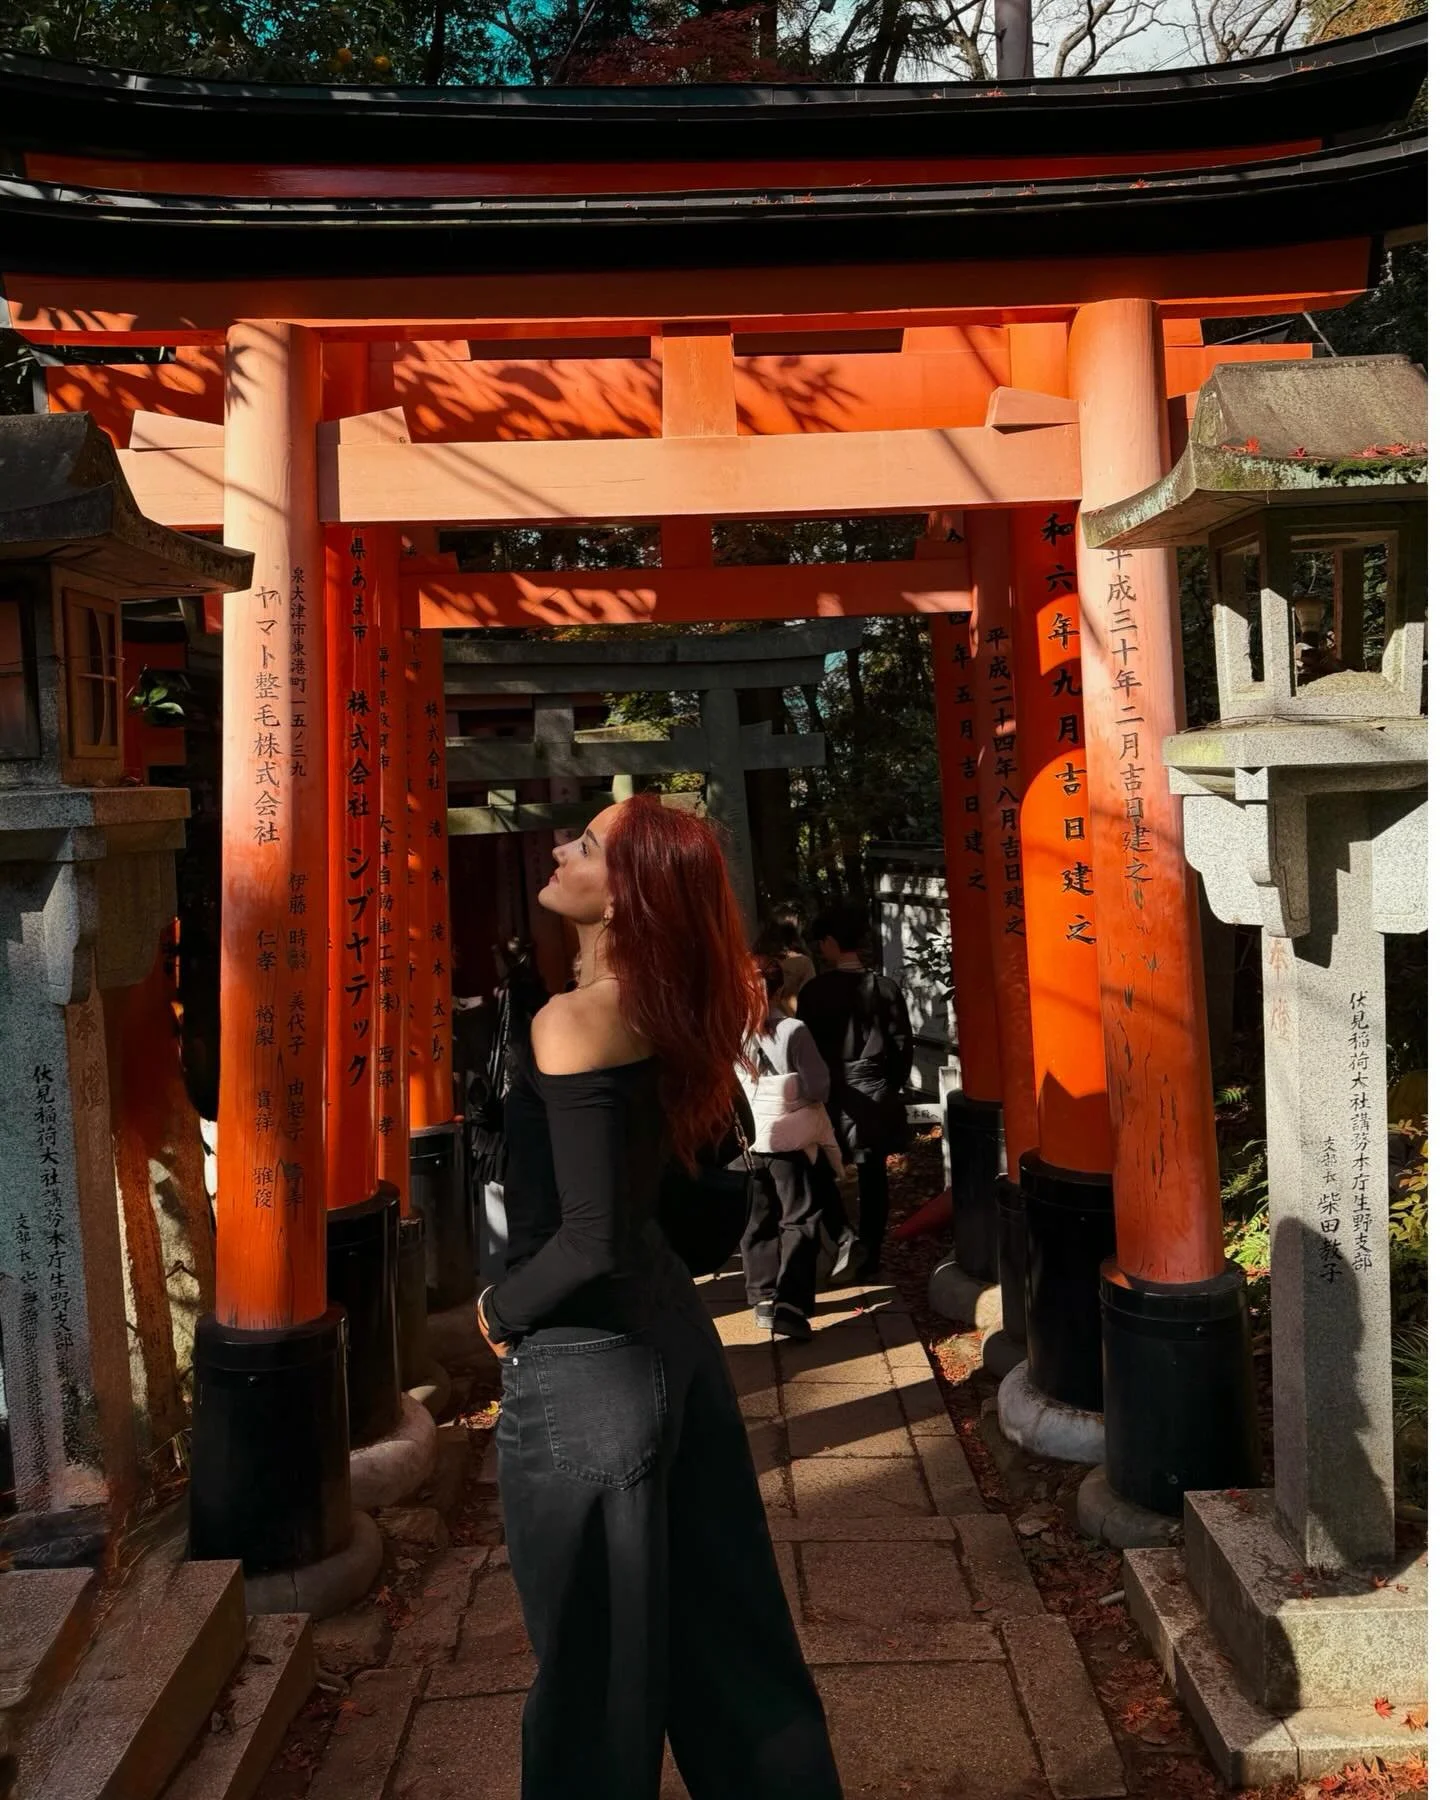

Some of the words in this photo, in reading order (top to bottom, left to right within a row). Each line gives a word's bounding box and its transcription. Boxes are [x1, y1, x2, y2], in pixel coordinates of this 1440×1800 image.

[253, 586, 282, 847] ヤマト整毛株式会社
[346, 690, 372, 818] 株式会社
[985, 626, 1025, 938] 平成二十四年八月吉日建之
[1040, 513, 1097, 945] 和六年九月吉日建之
[1106, 549, 1153, 882] 平成三十年二月吉日建之
[345, 848, 376, 1087] シブヤテック
[1321, 1136, 1338, 1184] 支部長
[1348, 991, 1373, 1273] 伏見稲荷大社講務本庁生野支部
